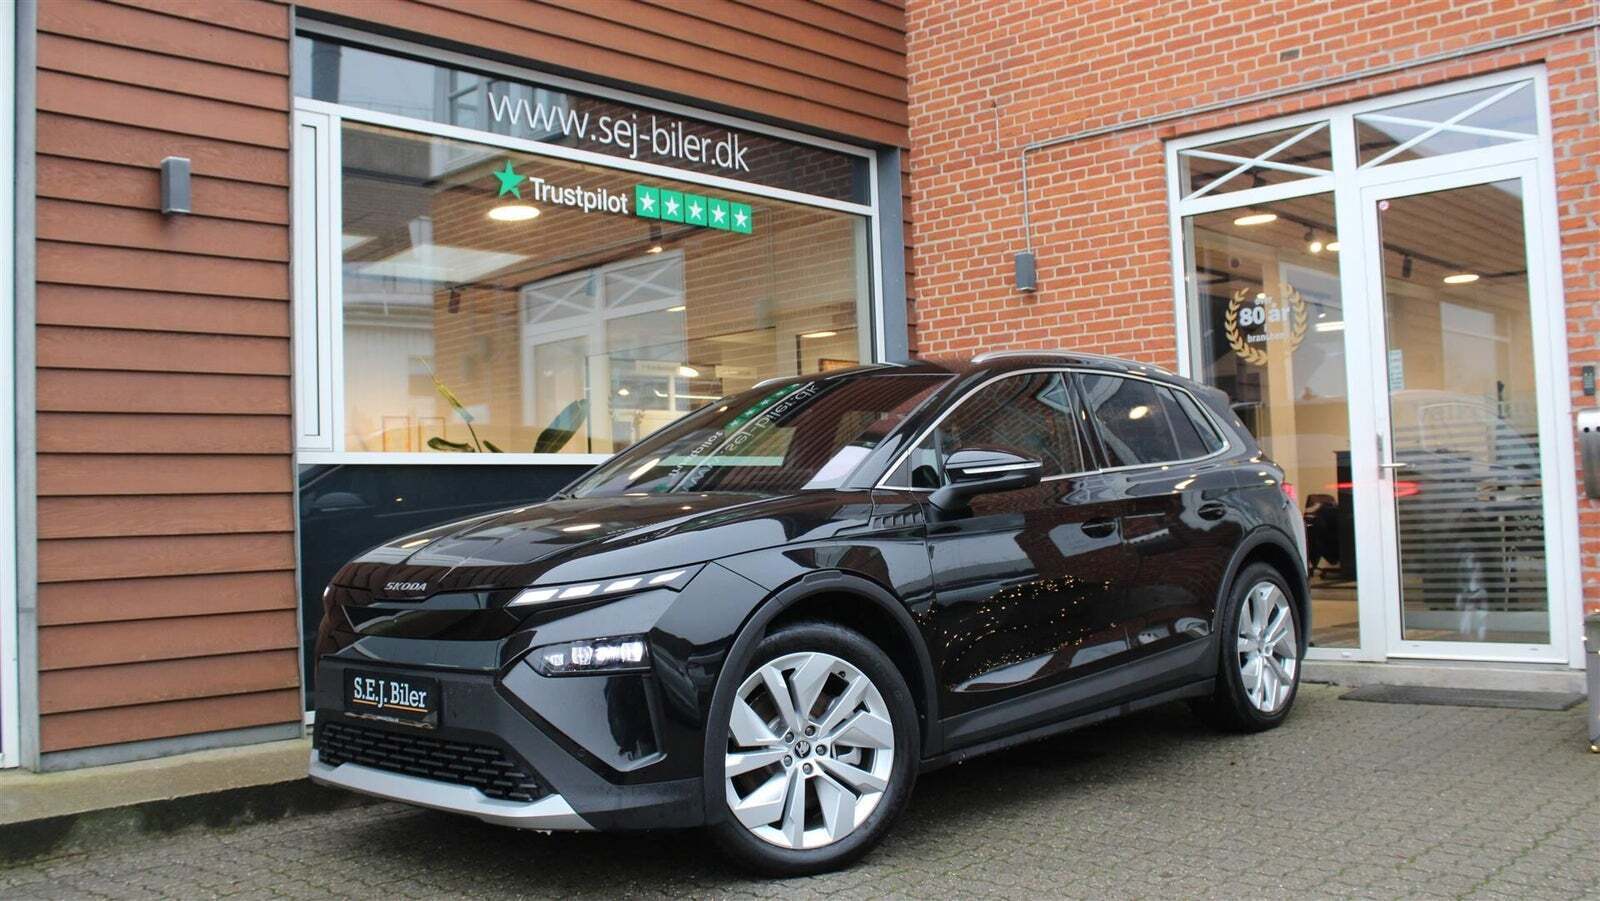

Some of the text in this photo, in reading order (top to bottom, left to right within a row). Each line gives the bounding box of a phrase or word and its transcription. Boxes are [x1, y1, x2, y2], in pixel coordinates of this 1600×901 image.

[488, 92, 750, 172] www.sej-biler.dk
[529, 177, 628, 214] Trustpilot
[1239, 306, 1265, 327] 80
[353, 677, 427, 708] S.E.J. Biler
